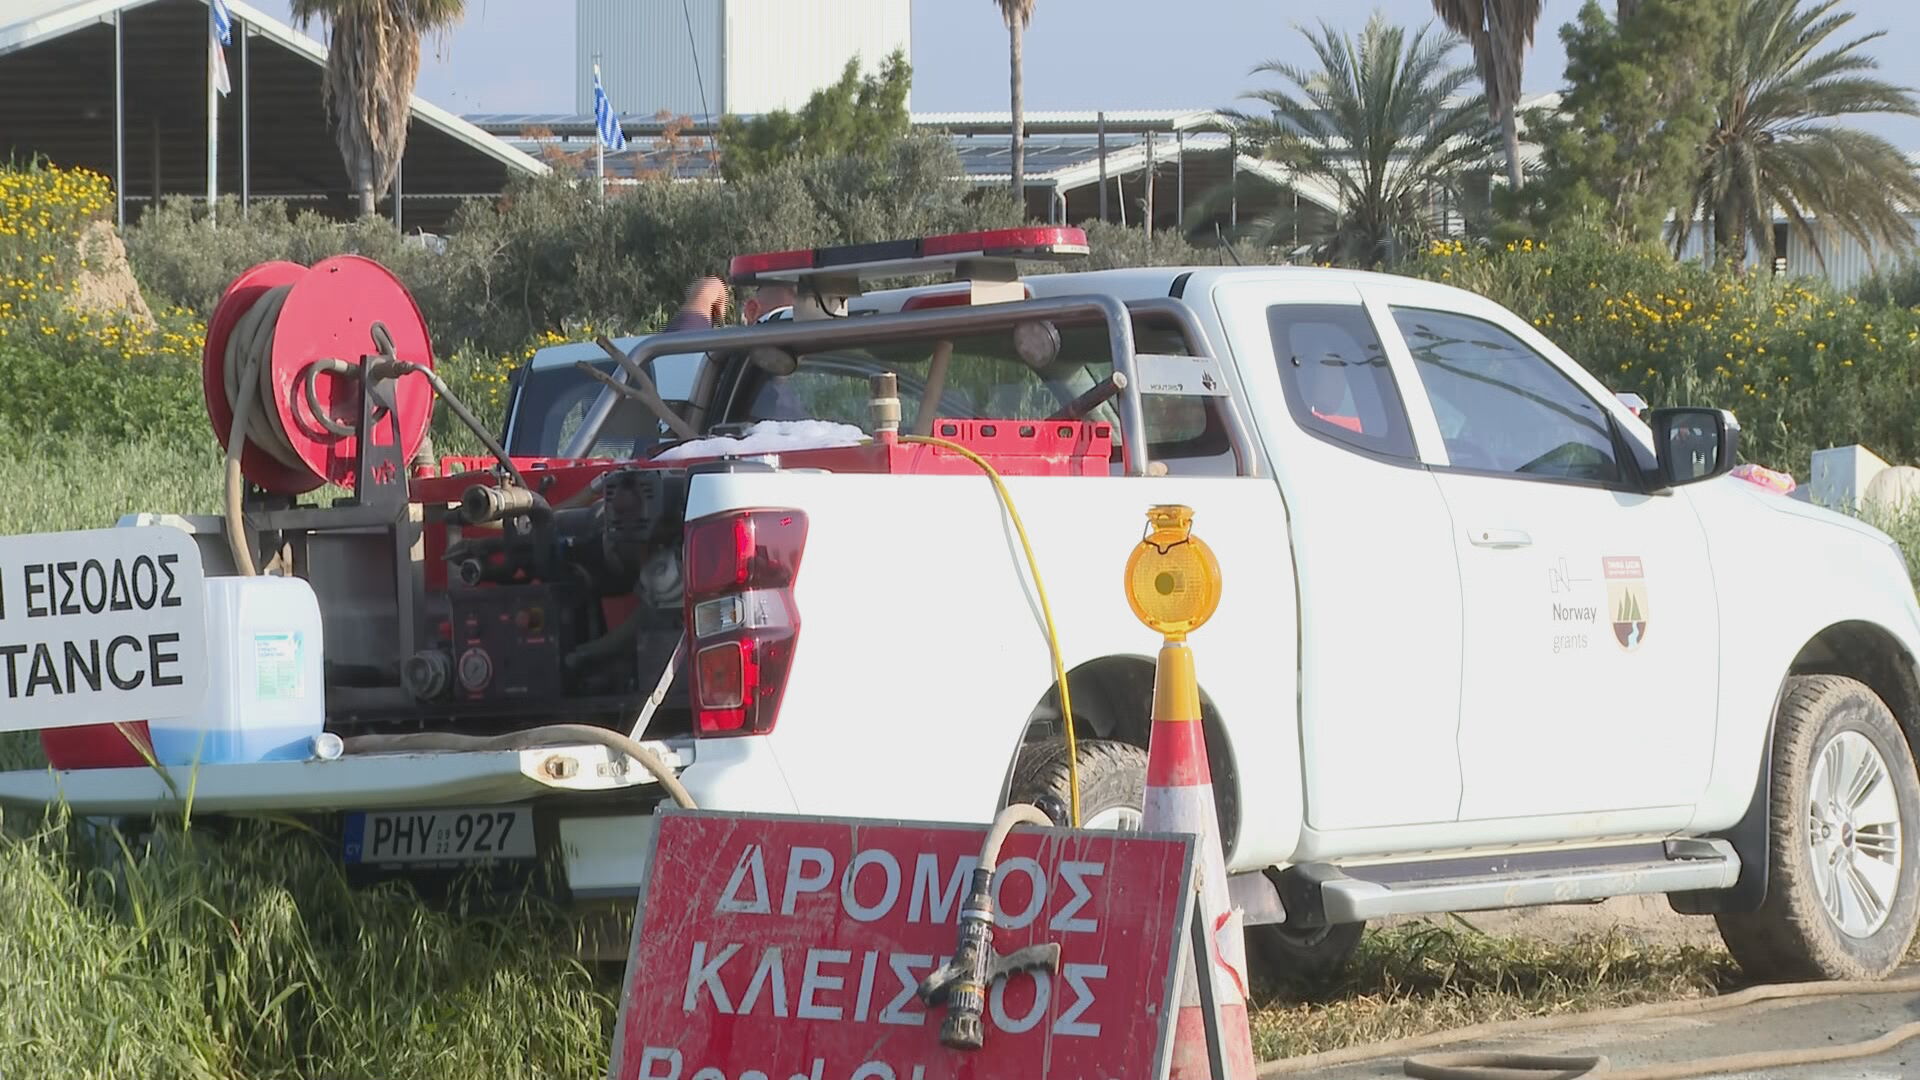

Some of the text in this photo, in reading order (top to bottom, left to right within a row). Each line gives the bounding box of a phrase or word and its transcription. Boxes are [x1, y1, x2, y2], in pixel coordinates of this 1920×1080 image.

[24, 554, 182, 618] ΕΙΣΟΔΟΣ
[1552, 602, 1597, 624] Norway
[0, 633, 183, 698] TANCE
[1552, 633, 1588, 654] grants
[373, 812, 516, 857] PHY 927
[715, 843, 1105, 933] ΔΡΟΜΟΣ
[682, 940, 1108, 1037] ΚΛΕΙΣΟΣ
